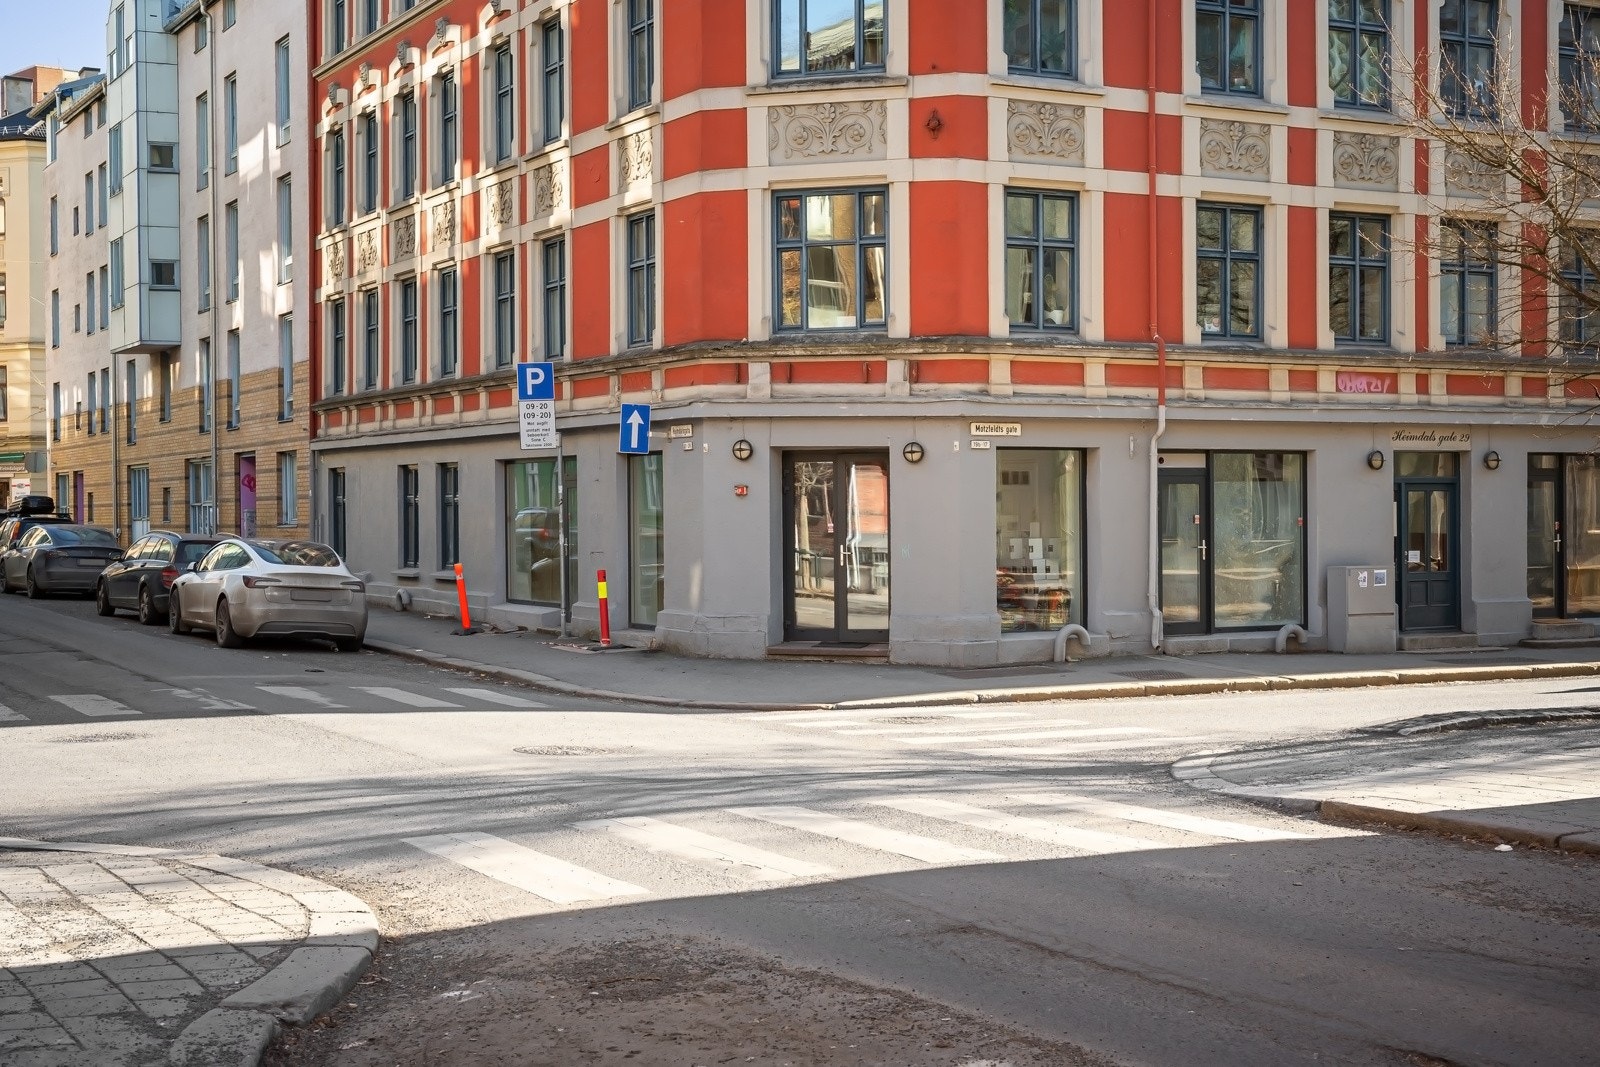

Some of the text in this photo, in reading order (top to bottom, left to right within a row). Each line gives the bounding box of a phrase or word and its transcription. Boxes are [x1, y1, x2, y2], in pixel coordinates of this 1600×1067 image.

[526, 367, 545, 396] P
[1005, 425, 1018, 434] gate
[1392, 429, 1470, 447] Heimdals gate 29
